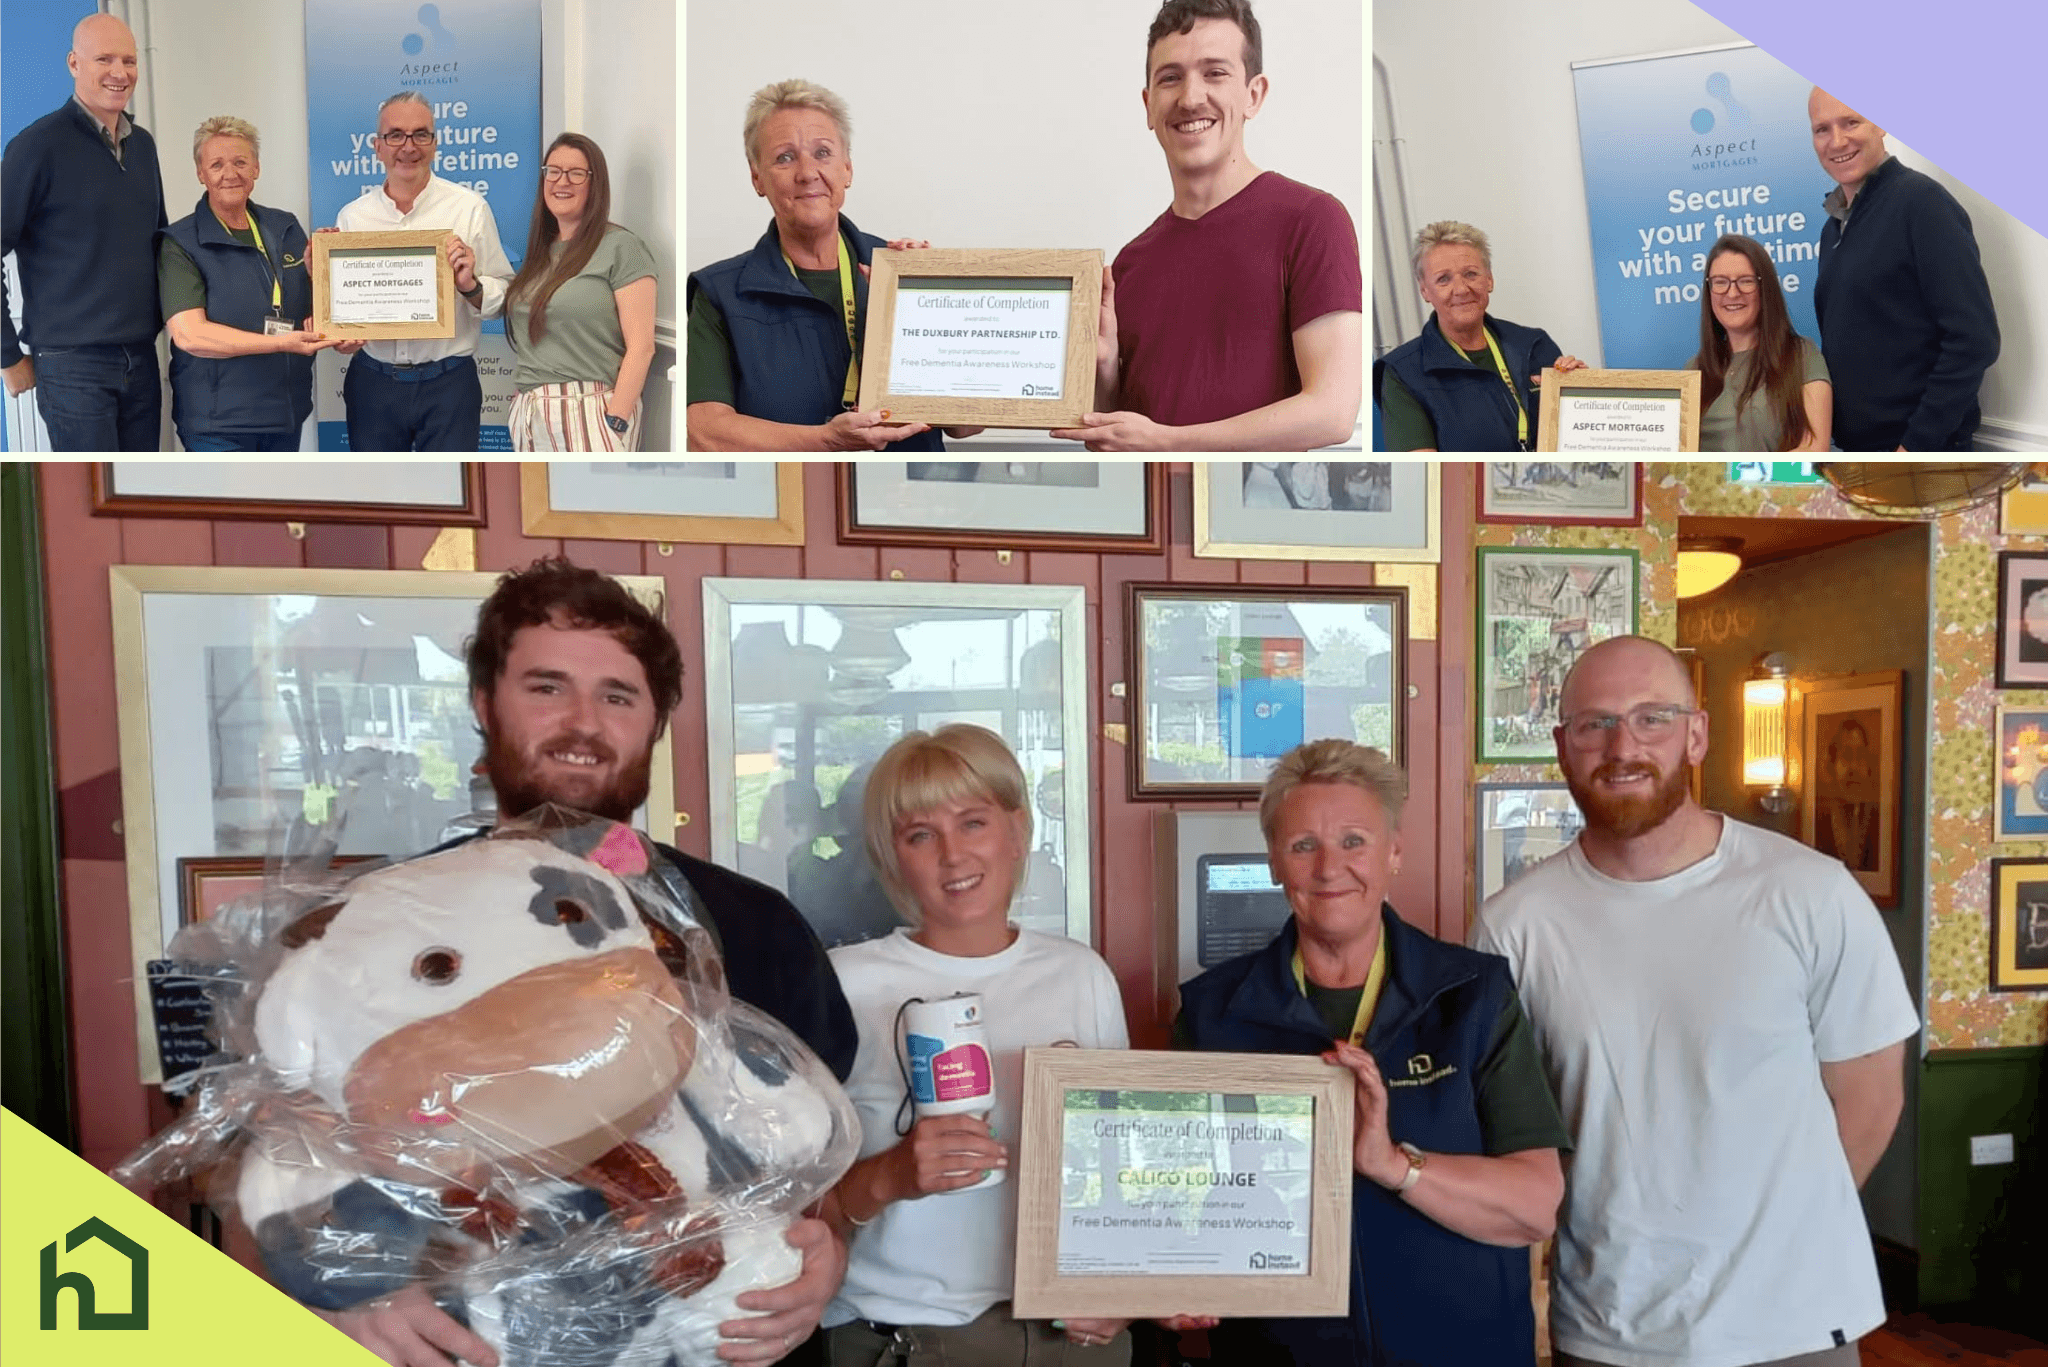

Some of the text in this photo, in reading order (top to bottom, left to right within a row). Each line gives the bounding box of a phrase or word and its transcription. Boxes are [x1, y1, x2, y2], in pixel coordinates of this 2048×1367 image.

[400, 61, 458, 77] Aspect
[1691, 139, 1756, 159] Aspect
[331, 149, 519, 176] with fetime
[1692, 156, 1758, 171] MORTGAGES
[1668, 184, 1770, 213] Secure
[1638, 222, 1706, 252] your
[342, 259, 423, 269] Certificate of Completion
[1618, 250, 1707, 278] with a
[343, 279, 424, 288] ASPECT MORTGAGES
[917, 295, 1050, 312] Certificate of Completion
[902, 328, 1061, 339] THE DUXBURY PARTNERSHIP LTD.
[477, 357, 501, 365] your
[901, 358, 1056, 369] Free Dementia Awareness Workshop
[498, 366, 513, 375] for
[485, 394, 503, 402] you
[481, 405, 502, 413] you.
[1574, 400, 1666, 413] Certificate of Completion
[1572, 422, 1665, 432] ASPECT MORTGAGES
[1094, 1119, 1283, 1145] Certificate of Completion
[1117, 1170, 1257, 1187] CALICO LOUNGE
[1072, 1215, 1100, 1227] Free
[1102, 1216, 1163, 1228] Dementia
[1233, 1217, 1295, 1230] Workshop
